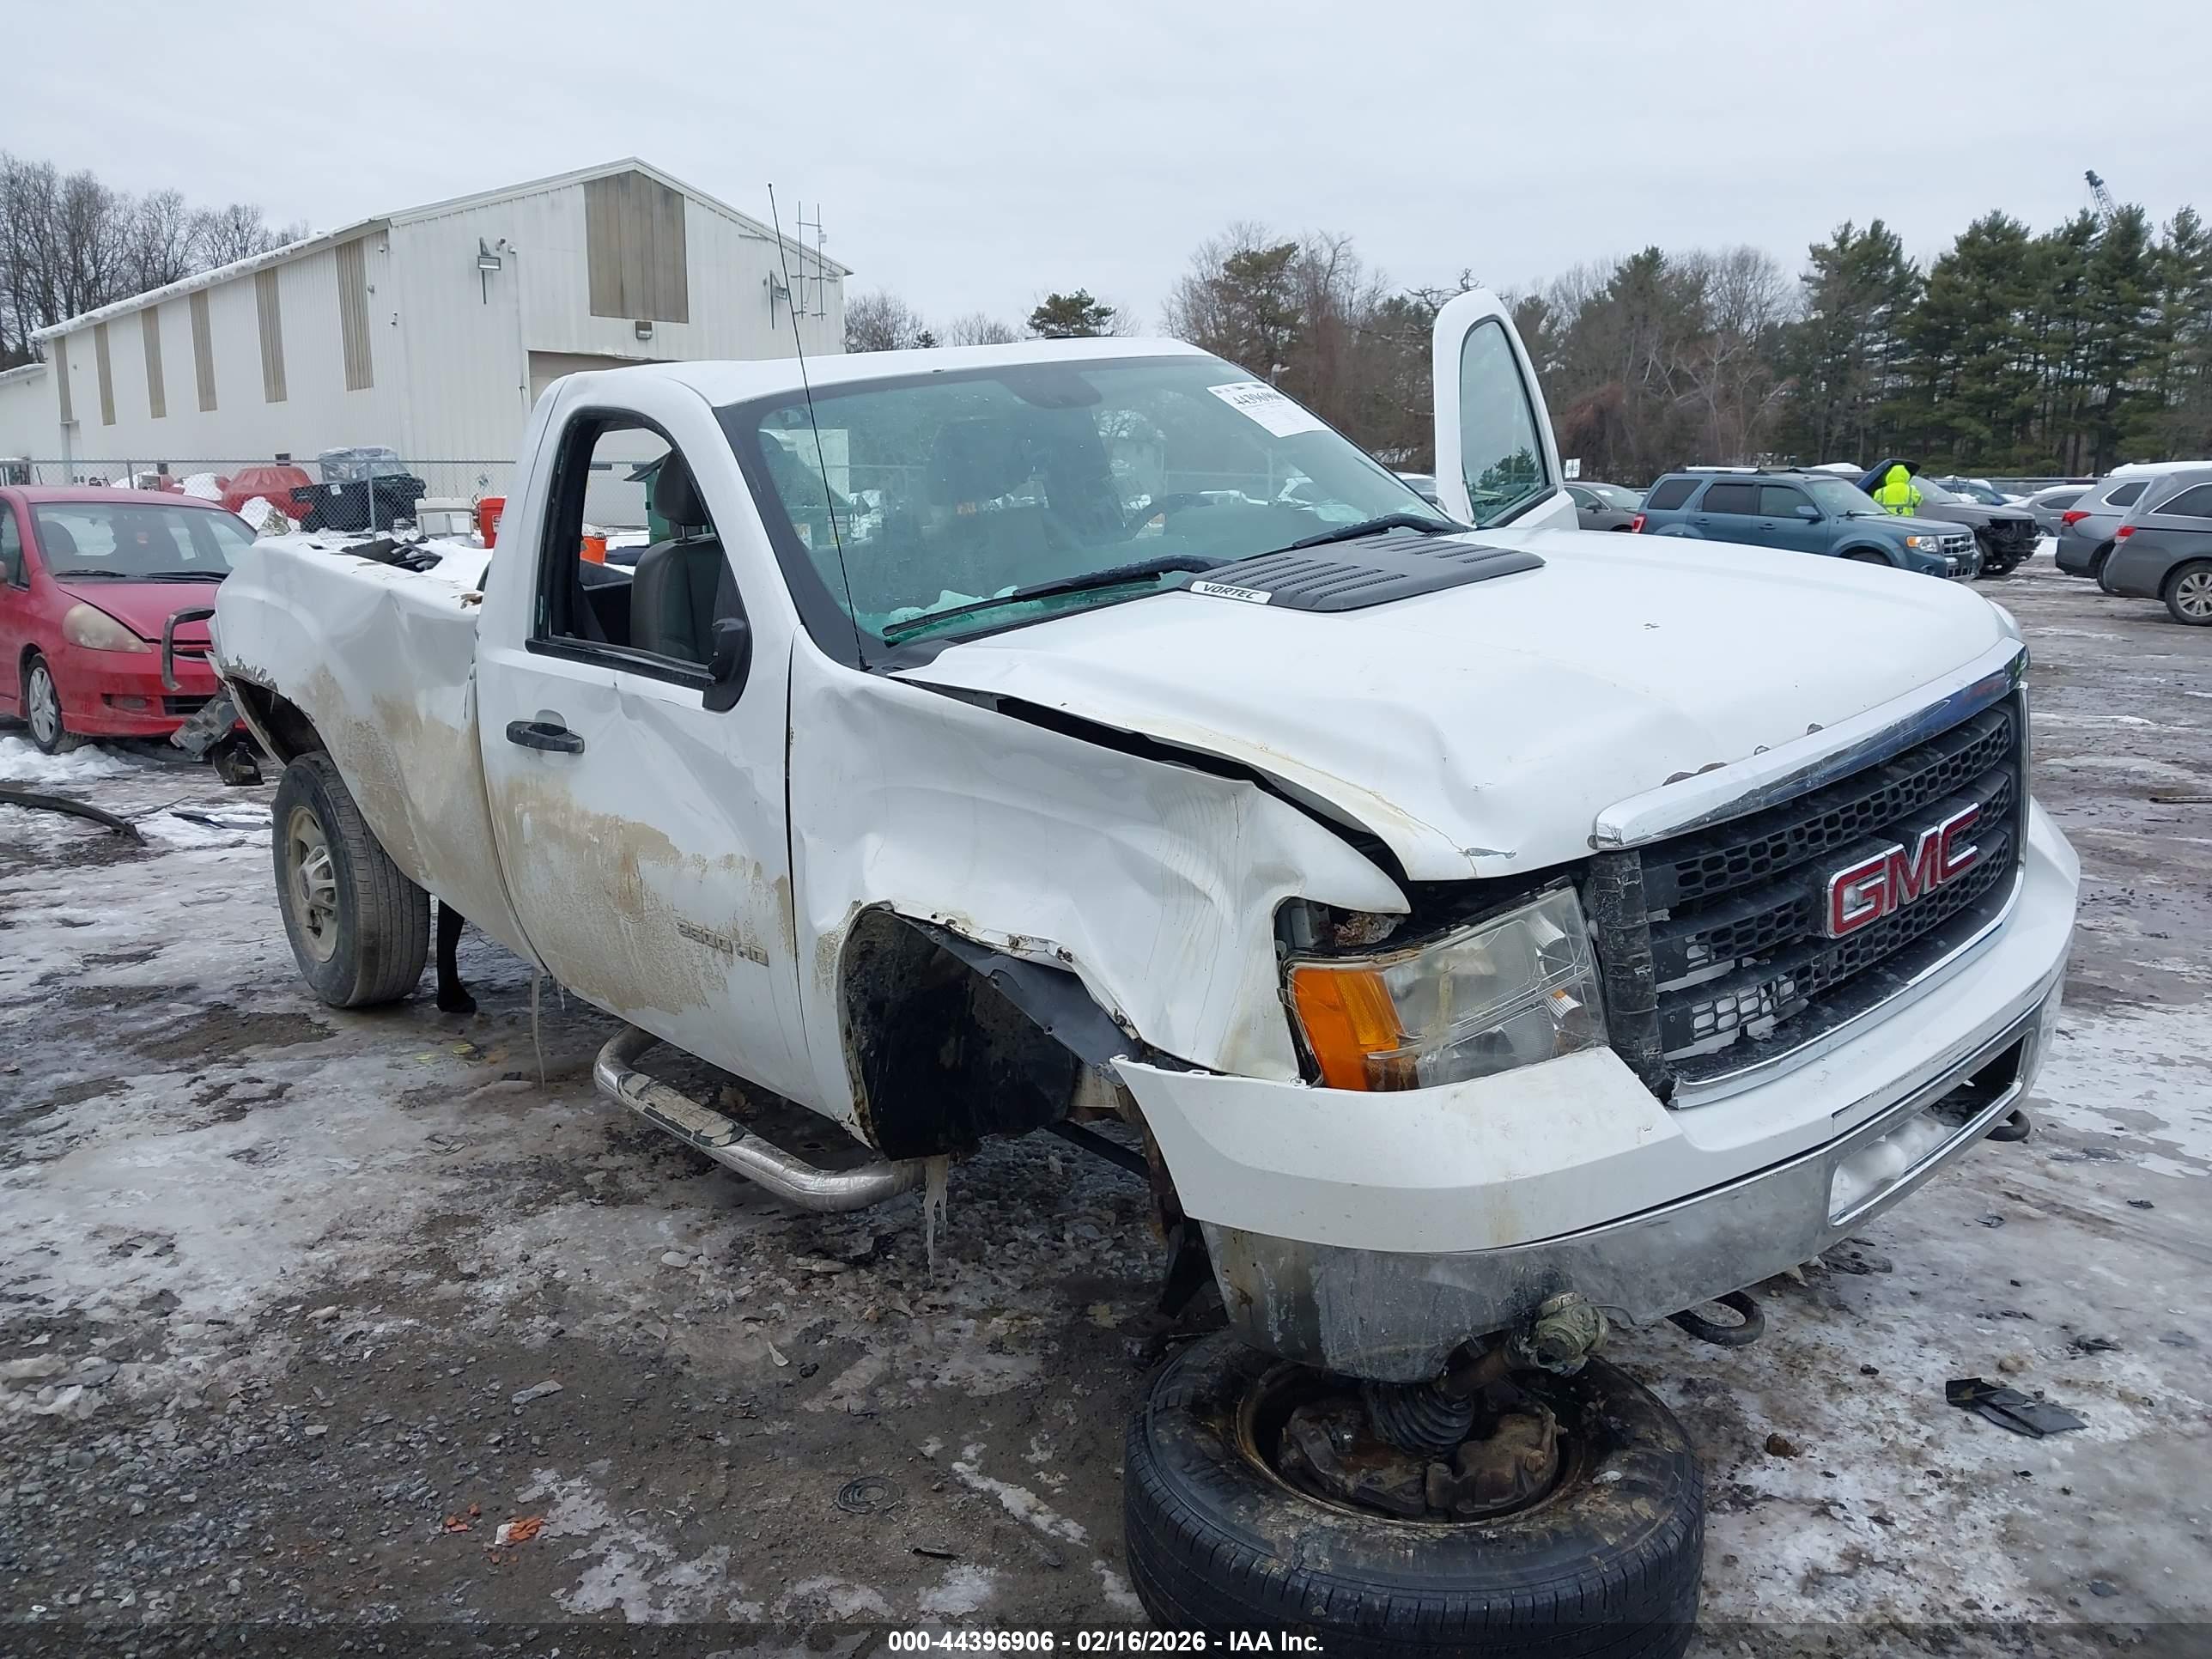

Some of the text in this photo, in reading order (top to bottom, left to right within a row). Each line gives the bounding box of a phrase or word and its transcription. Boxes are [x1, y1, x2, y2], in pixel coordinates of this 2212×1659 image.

[1203, 584, 1260, 599] VORTEC
[1826, 802, 1979, 939] GMC
[676, 920, 769, 967] 2500 HD
